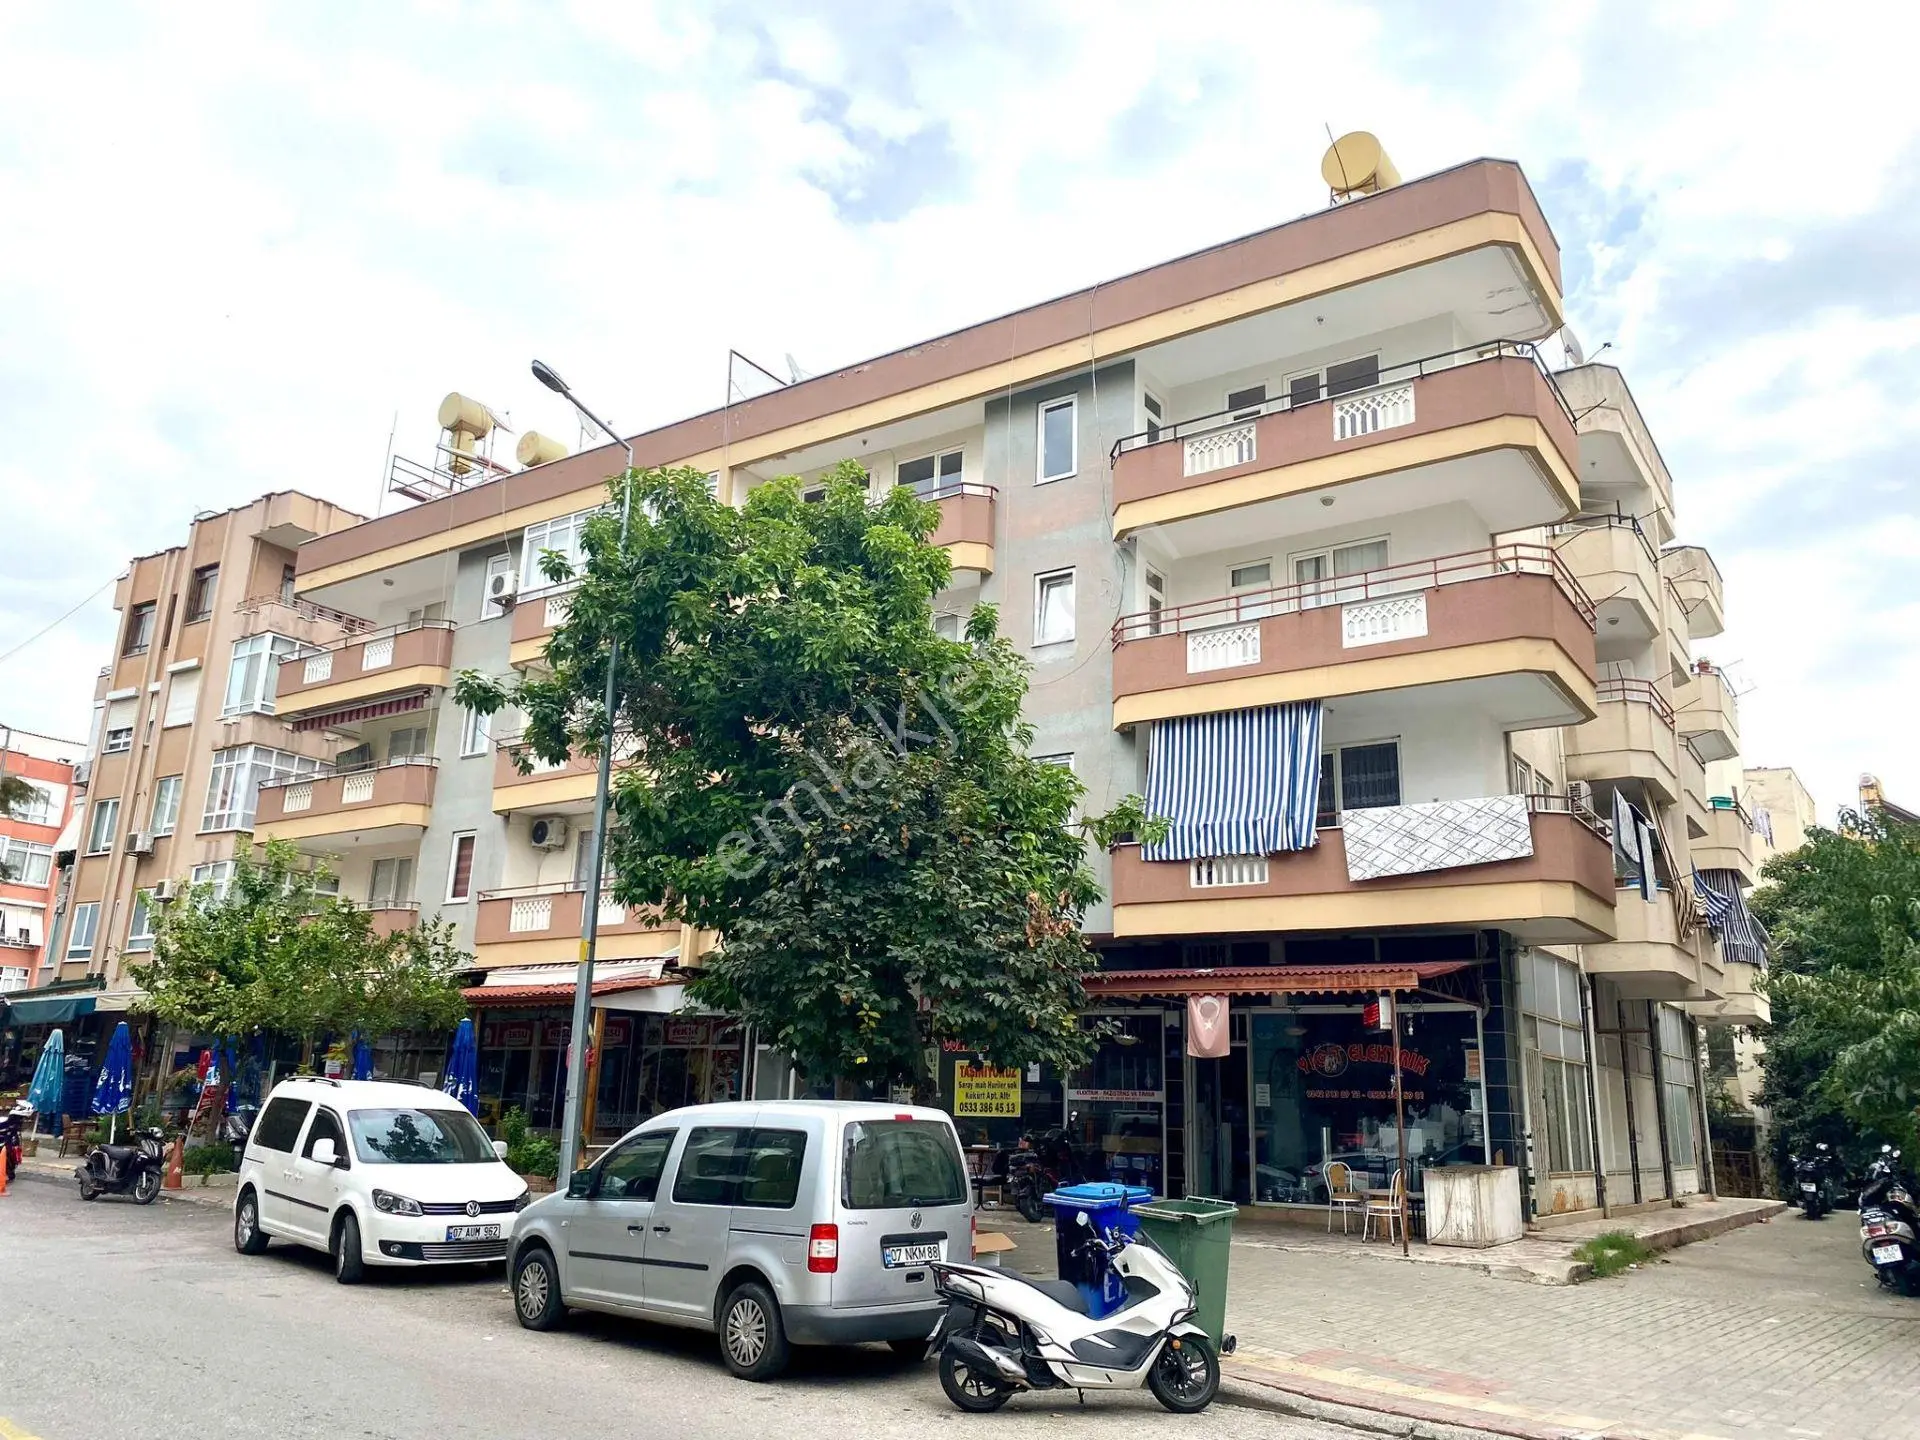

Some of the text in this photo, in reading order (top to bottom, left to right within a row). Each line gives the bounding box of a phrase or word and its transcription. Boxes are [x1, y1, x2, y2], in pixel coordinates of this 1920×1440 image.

[959, 1102, 1016, 1113] 0533 386 45 13
[453, 1227, 463, 1237] 07
[484, 1226, 498, 1236] 962
[891, 1244, 938, 1262] 07 NKM 88
